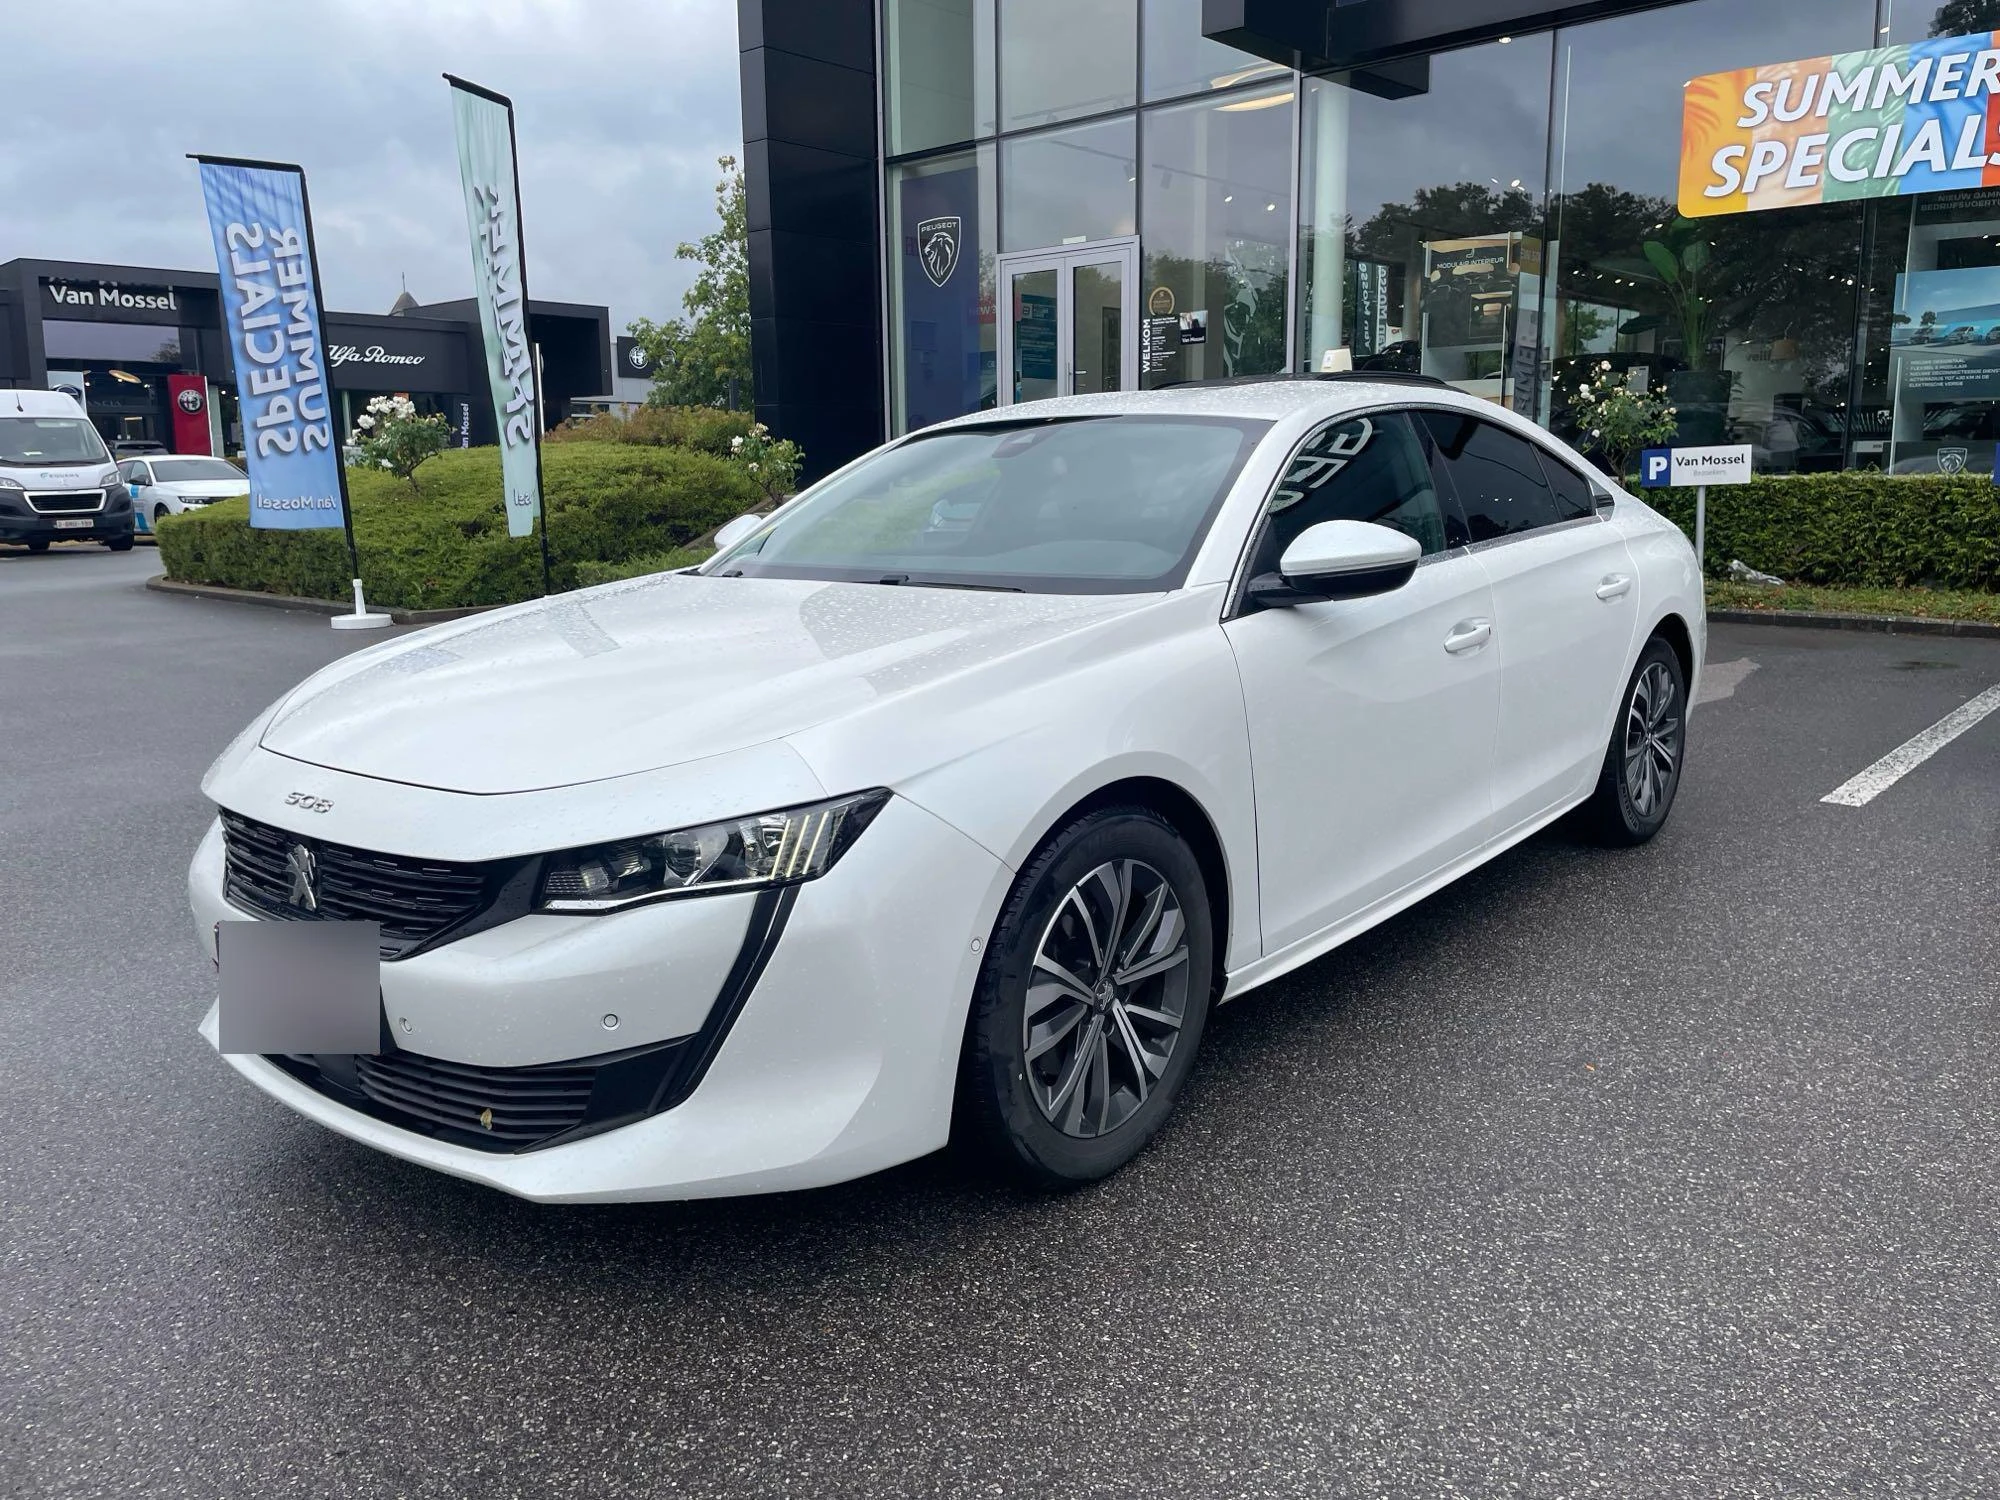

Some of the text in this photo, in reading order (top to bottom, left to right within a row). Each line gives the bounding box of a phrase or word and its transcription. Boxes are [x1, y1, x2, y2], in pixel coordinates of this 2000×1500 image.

[1736, 49, 2000, 128] SUMMER
[1703, 115, 2000, 198] SPECIAL
[921, 221, 958, 232] PEUGEOT
[49, 285, 177, 311] Van Mossel
[363, 345, 426, 365] Romeo
[1142, 318, 1151, 373] WELKOM
[460, 403, 470, 435] Mossel
[1676, 454, 1745, 466] Van Mossel
[284, 791, 335, 814] 508
